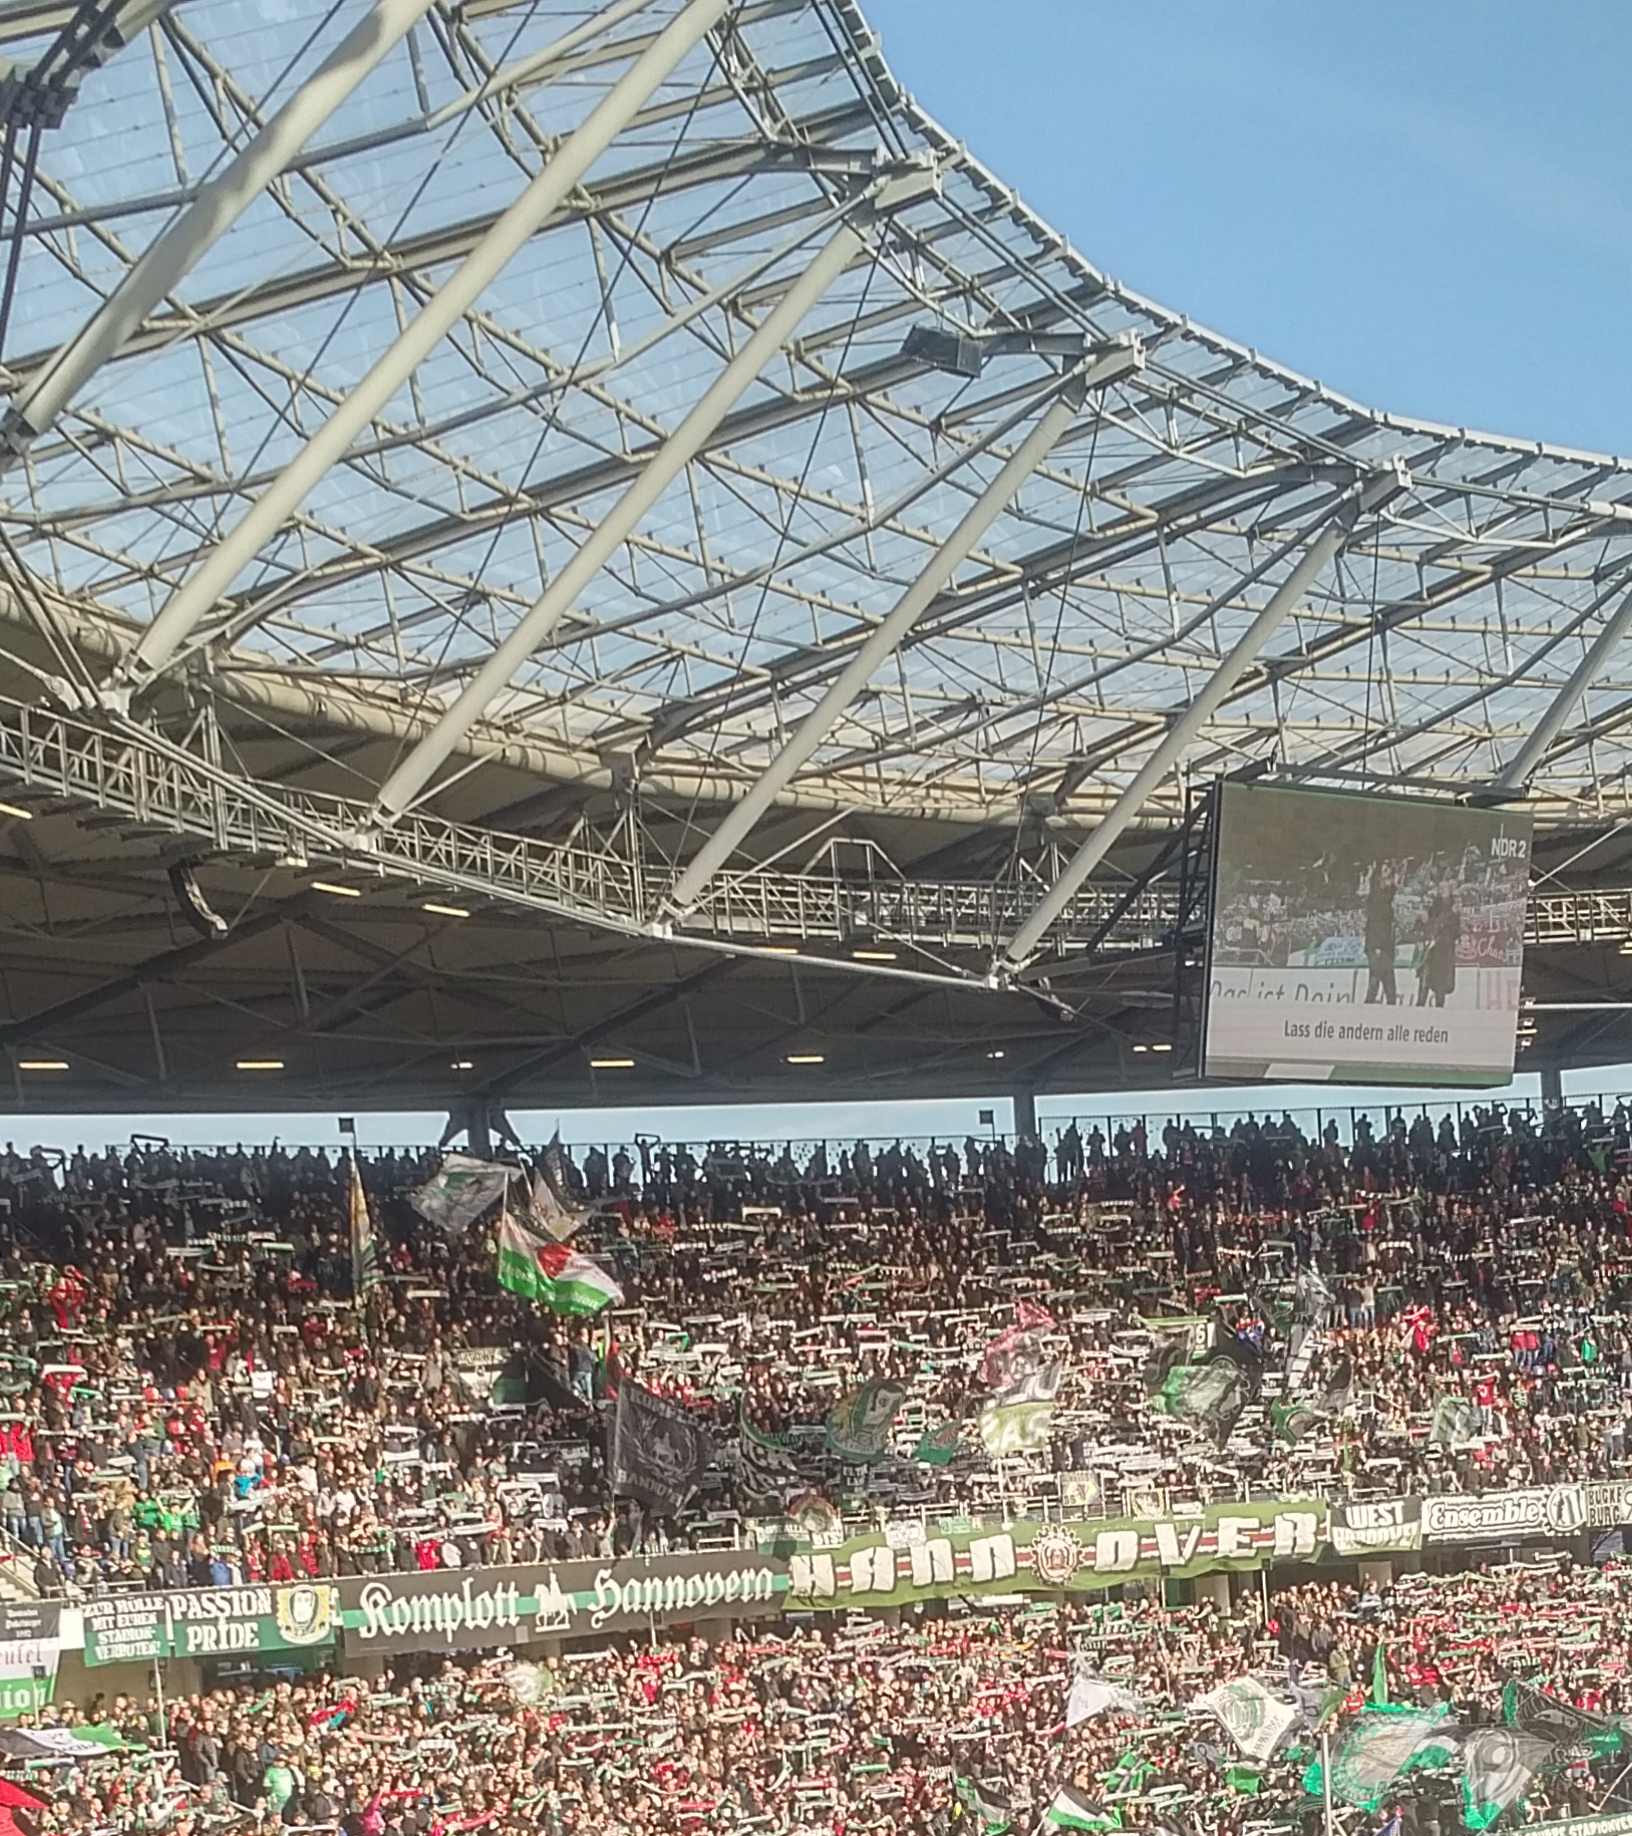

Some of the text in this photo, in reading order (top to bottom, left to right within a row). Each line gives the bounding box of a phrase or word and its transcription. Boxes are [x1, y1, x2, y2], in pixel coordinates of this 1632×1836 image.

[1492, 838, 1517, 857] NDR
[1284, 1020, 1448, 1043] Lass die andern alle reden
[1345, 1501, 1405, 1529] WEST
[1431, 1496, 1541, 1530] Ensemble
[84, 1600, 116, 1618] ZUR
[169, 1589, 272, 1620] PASSION
[359, 1567, 775, 1643] Komplott Hannovera
[91, 1614, 116, 1631] MIT
[186, 1616, 260, 1652] PRIDE
